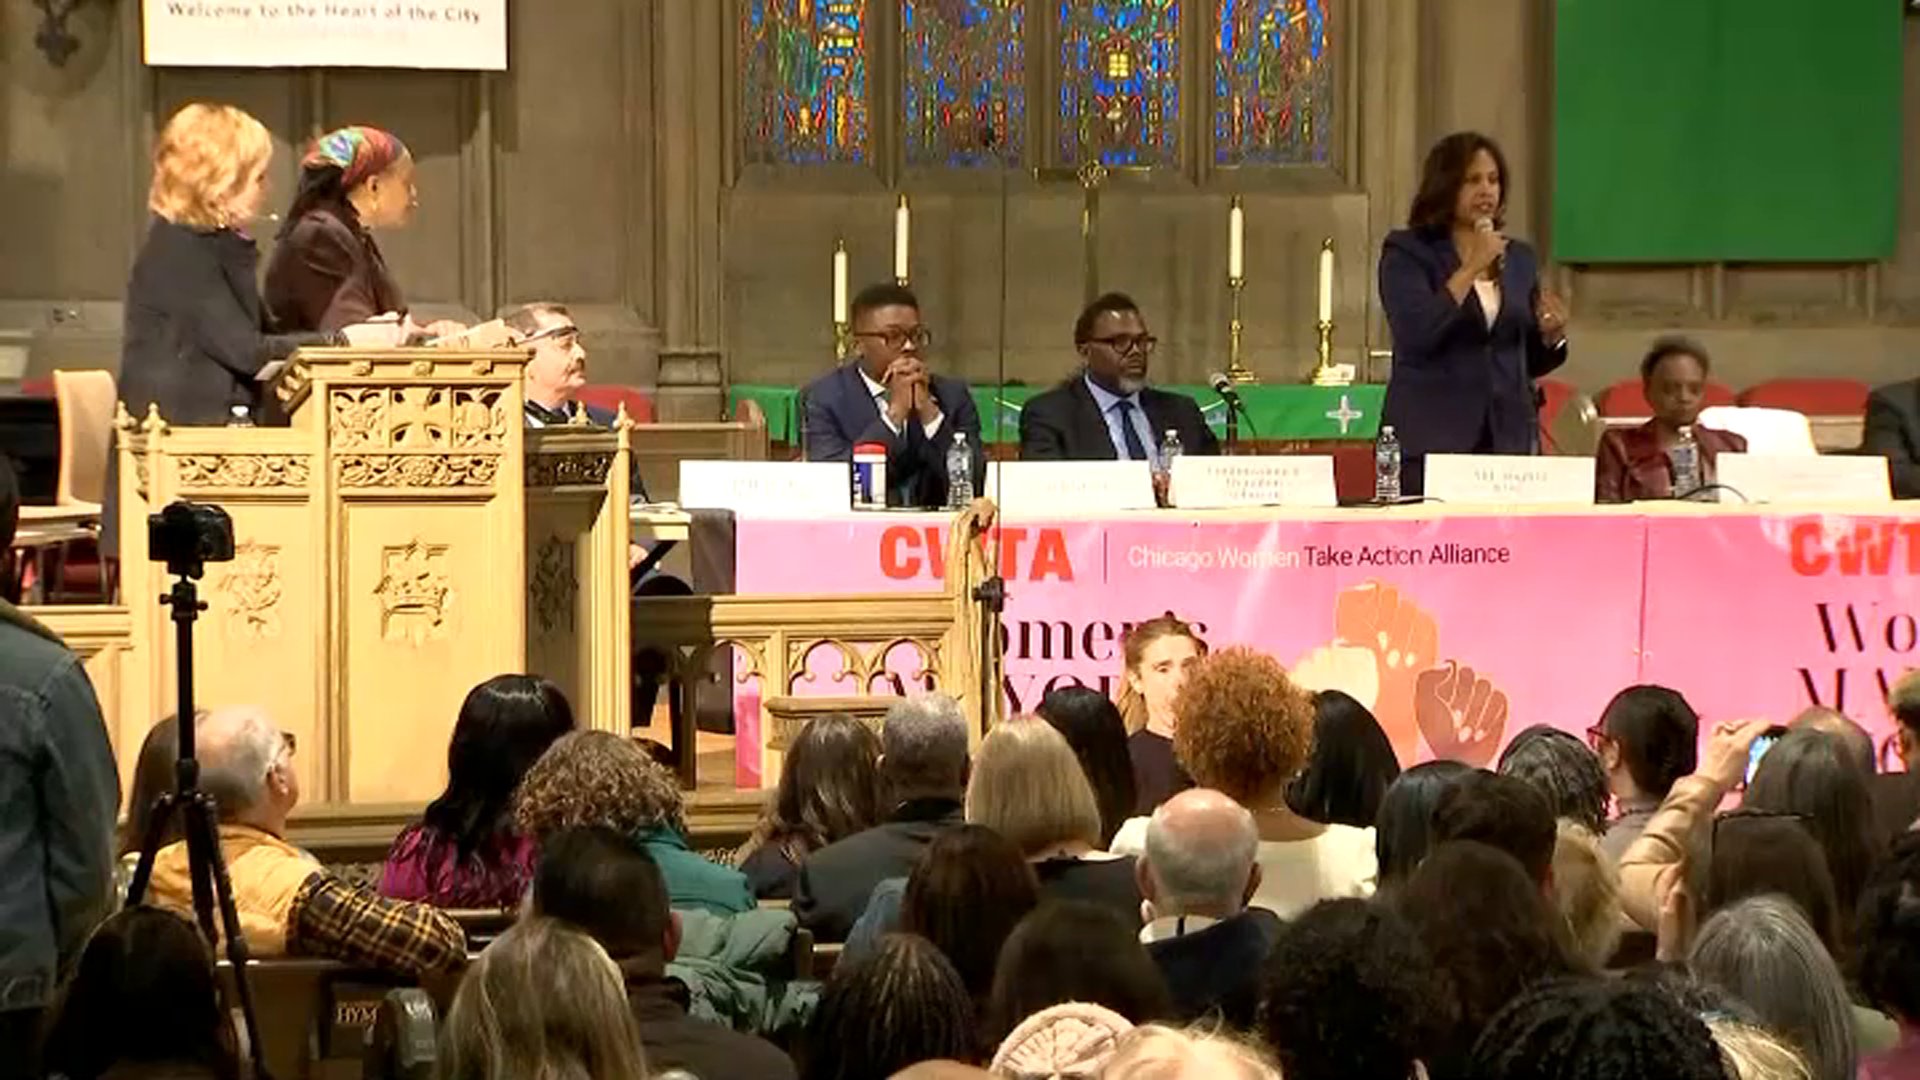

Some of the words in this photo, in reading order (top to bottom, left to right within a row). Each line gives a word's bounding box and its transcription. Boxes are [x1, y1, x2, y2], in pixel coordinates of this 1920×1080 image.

[167, 2, 251, 17] Welcome
[259, 4, 279, 17] to
[287, 4, 316, 17] the
[324, 4, 377, 17] Heart
[384, 4, 402, 18] of
[409, 6, 437, 20] the
[444, 7, 480, 24] City
[1127, 545, 1213, 573] Chicago
[1217, 546, 1300, 569] Women
[1303, 545, 1353, 567] Take
[1356, 545, 1423, 566] Action
[1428, 543, 1510, 565] Alliance
